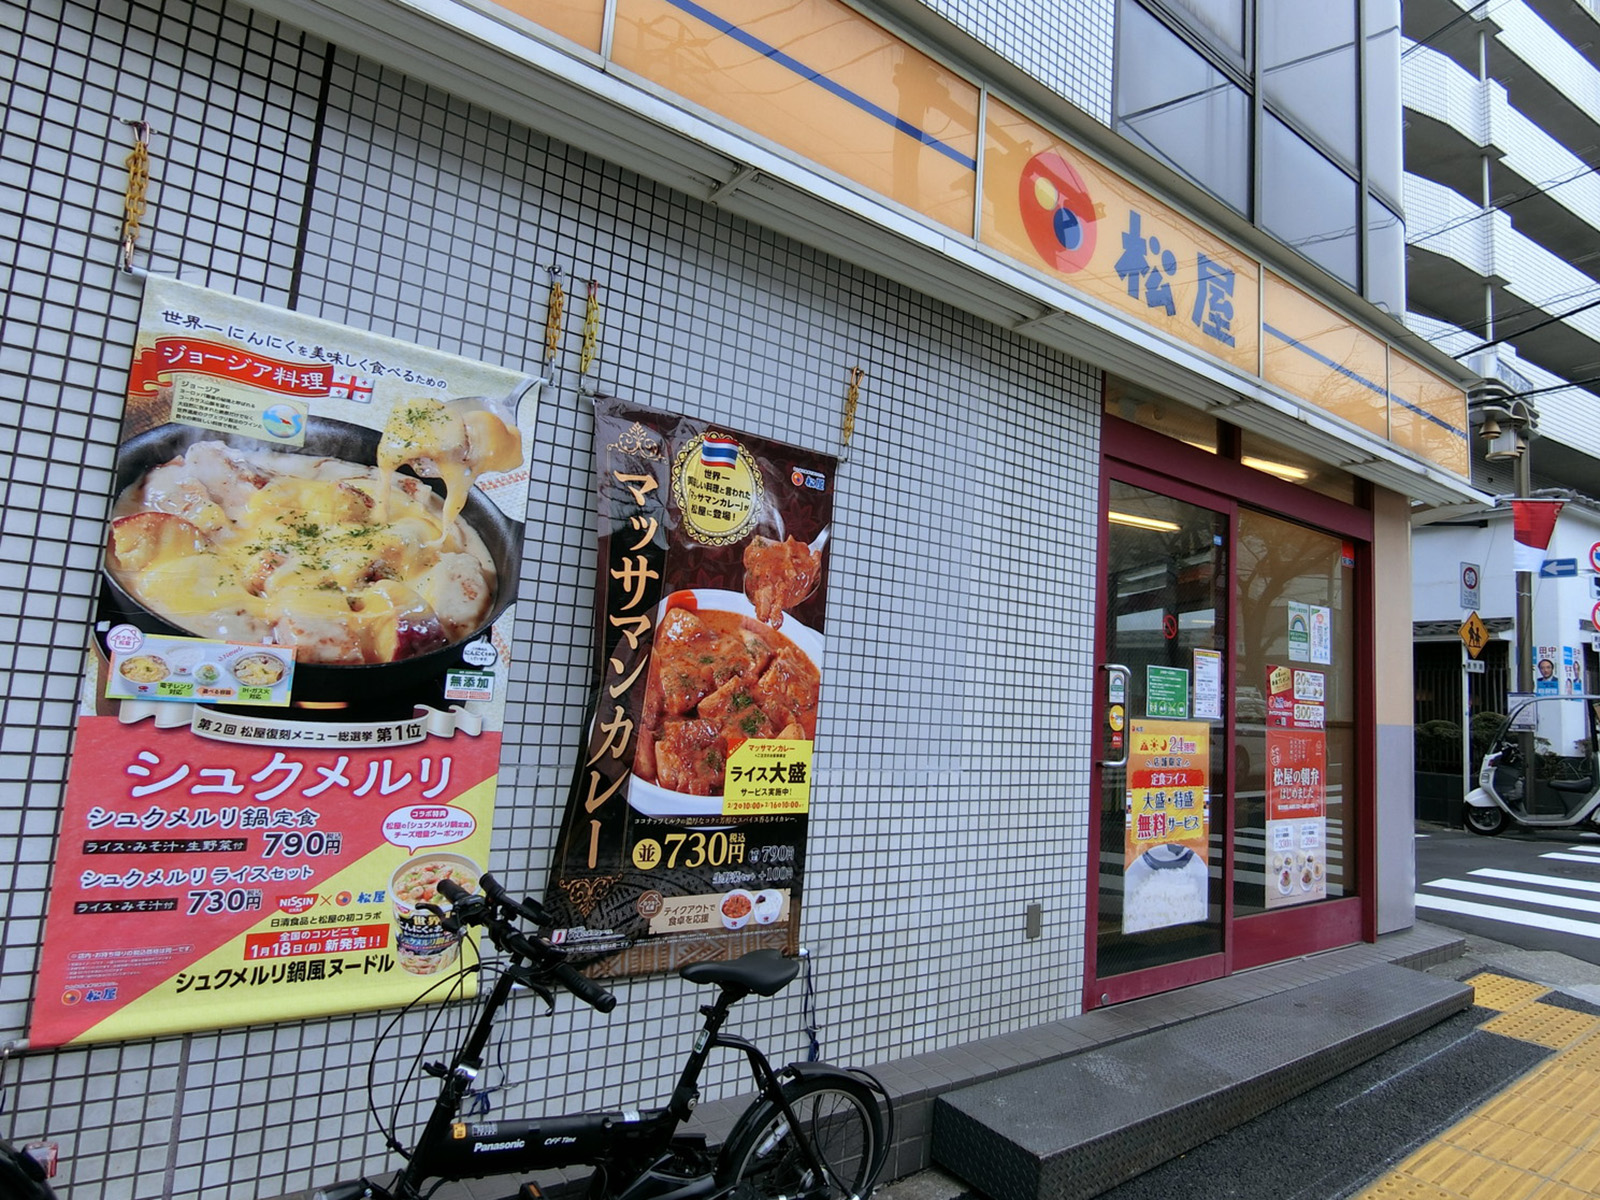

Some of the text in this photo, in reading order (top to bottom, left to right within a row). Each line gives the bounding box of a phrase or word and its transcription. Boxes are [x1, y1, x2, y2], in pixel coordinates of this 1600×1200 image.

[1114, 209, 1236, 349] 松屋
[161, 309, 448, 390] 世界一にんにくを美味しく食べるための
[163, 343, 329, 391] ジョージア料理
[181, 380, 220, 394] ジョージア
[704, 469, 730, 481] 世界一
[1539, 646, 1556, 655] 田中
[585, 470, 660, 871] マッサマンカレー
[159, 682, 193, 690] 電子レンジ
[450, 675, 490, 689] 無添加
[197, 718, 422, 743] 第2回 松屋復刻メニュー総選挙 第1位
[748, 744, 796, 752] マッサマンカレー
[1169, 736, 1196, 753] 24時間
[129, 752, 452, 801] シュクメルリ
[730, 761, 806, 784] ライス大盛
[1151, 773, 1187, 786] 定食ライス
[1143, 790, 1193, 811] 大盛・特盛
[88, 808, 319, 829] シュクメルリ鍋定食
[1137, 812, 1199, 838] 無料サービス
[85, 840, 245, 853] ライス・みそ汁・生野菜付
[262, 832, 341, 857] 790円
[729, 833, 746, 843] 税込
[638, 843, 655, 863] 並
[664, 832, 746, 869] 730円
[81, 866, 314, 889] シュクメルリライスセット
[77, 900, 175, 913] ライス・みそ汁付
[187, 889, 262, 915] 730円
[279, 890, 386, 907] NISSIN 松屋
[664, 904, 716, 916] テイクアウトで
[271, 911, 382, 927] 日清食品と松屋の初コラボ
[668, 913, 709, 927] 食卓を応援
[279, 927, 360, 942] 全国のコンビニで
[251, 940, 322, 958] 1月18日(月)
[325, 933, 382, 953] 新発売!!
[175, 955, 395, 994] シュクメルリ鍋風ヌードル
[86, 987, 118, 1002] 松屋
[473, 1138, 526, 1153] Panasonic
